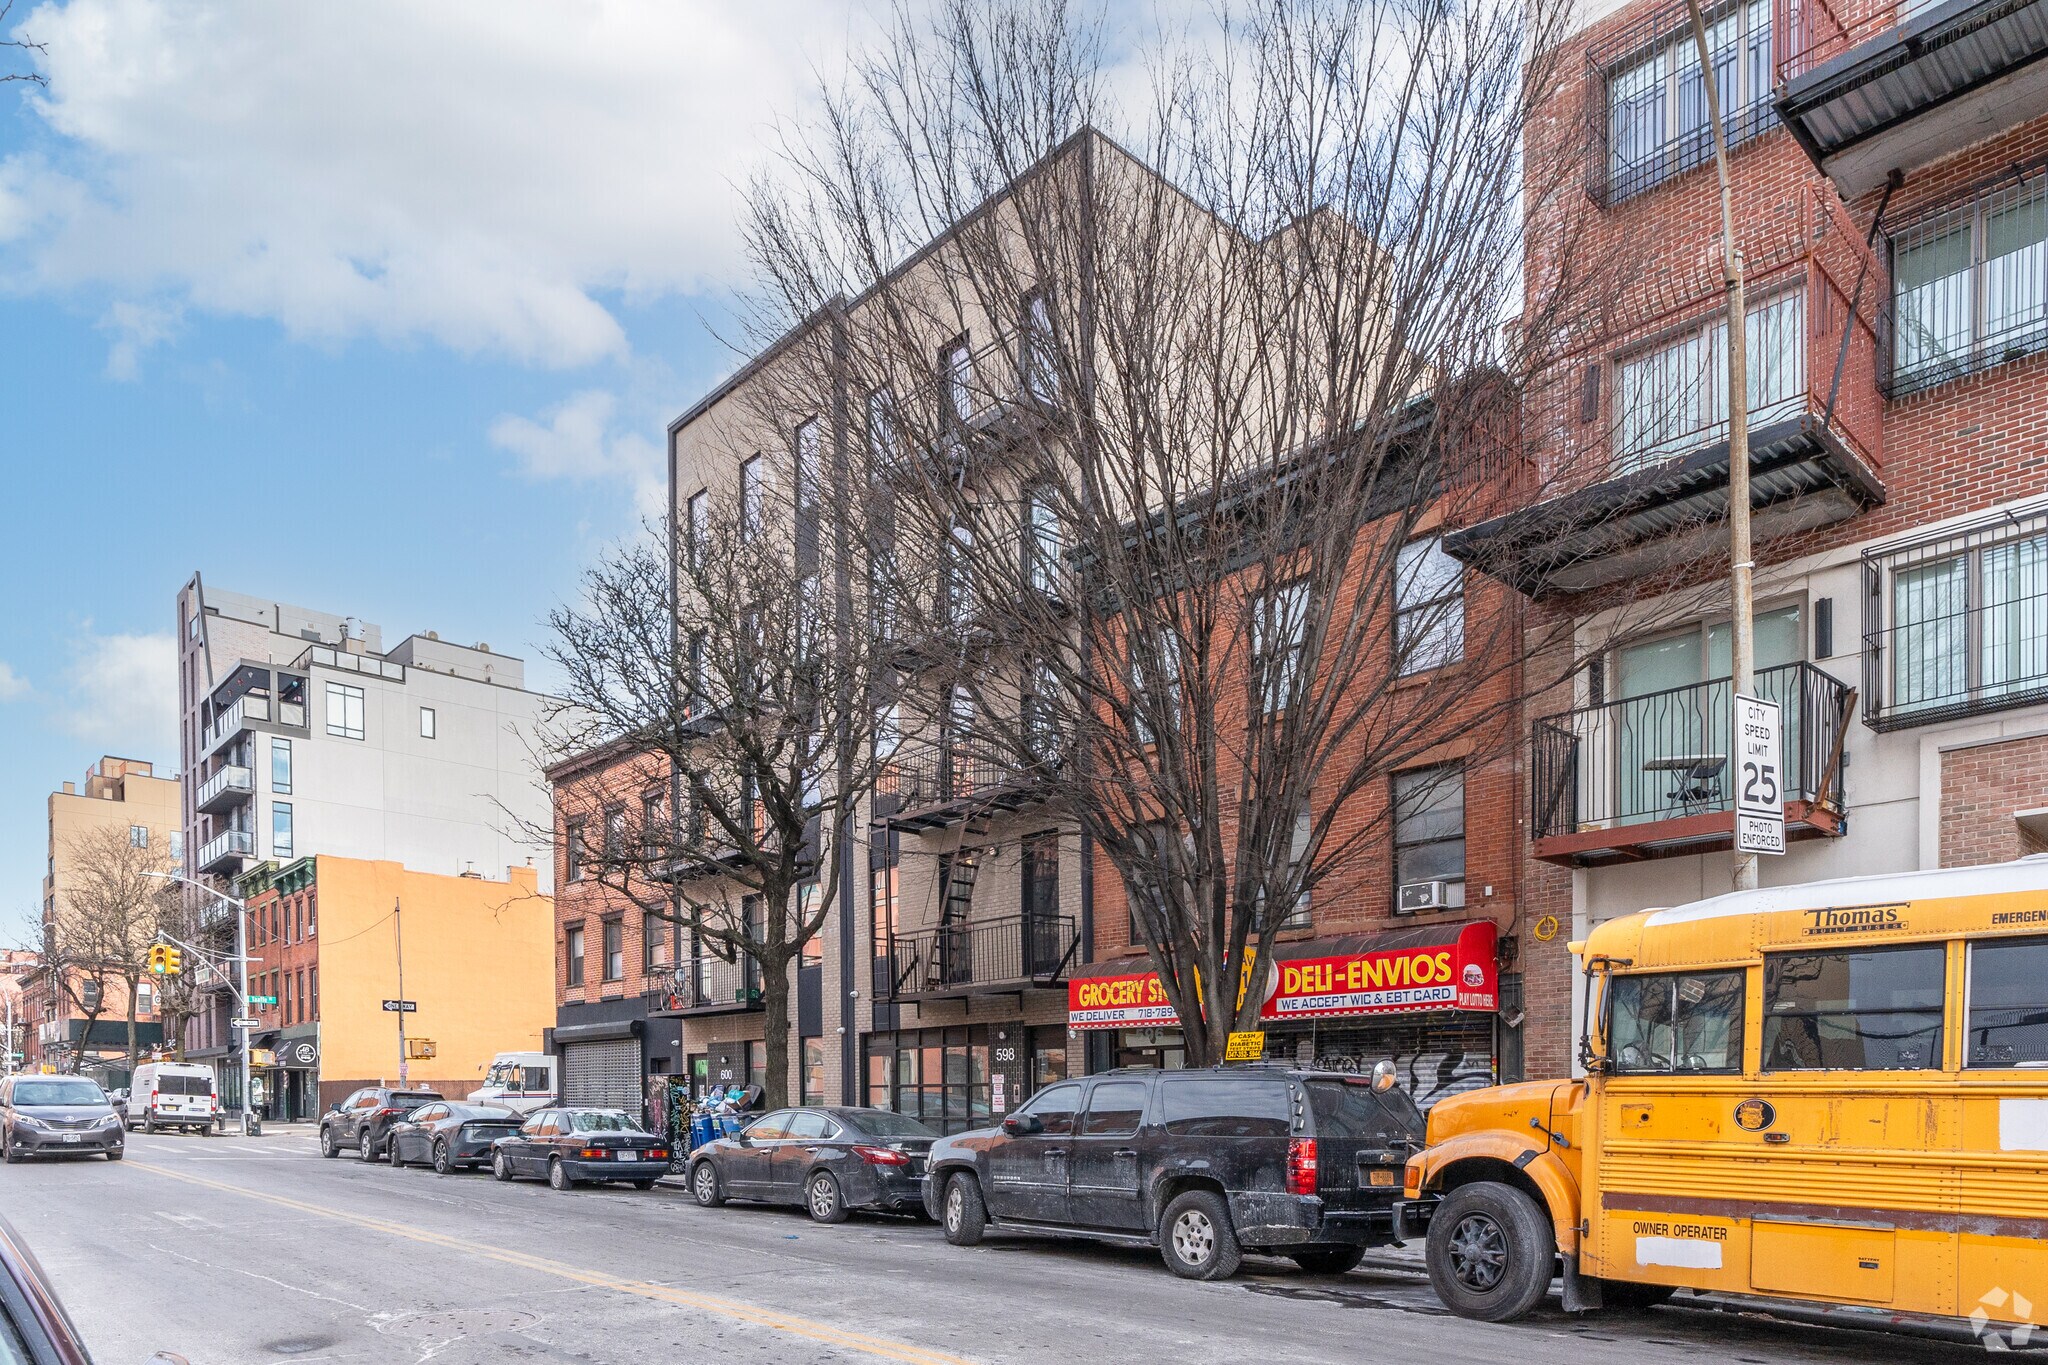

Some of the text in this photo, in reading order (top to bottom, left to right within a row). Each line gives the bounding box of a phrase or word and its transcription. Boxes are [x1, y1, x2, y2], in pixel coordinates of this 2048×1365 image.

[1748, 706, 1765, 721] CITY
[1745, 723, 1770, 740] SPEED
[1748, 742, 1768, 757] LIMIT
[1743, 761, 1776, 805] 25
[1749, 820, 1773, 834] PHOTO
[1742, 832, 1780, 847] ENFORCED
[1806, 903, 1905, 927] Thomas
[1992, 910, 2048, 925] EMERGEN
[1284, 952, 1452, 994] DELI-ENVIOS
[1079, 979, 1145, 1007] GROCERY
[1281, 988, 1451, 1010] WE ACCEPT WIC & EBT CARD
[1459, 992, 1494, 1007] PLAY LOTTO HERE
[1071, 1012, 1085, 1021] WE
[1086, 1010, 1125, 1020] DELIVER
[996, 1047, 1015, 1061] 598
[720, 1069, 733, 1080] 600
[1633, 1221, 1728, 1240] OWNER OPERATER
